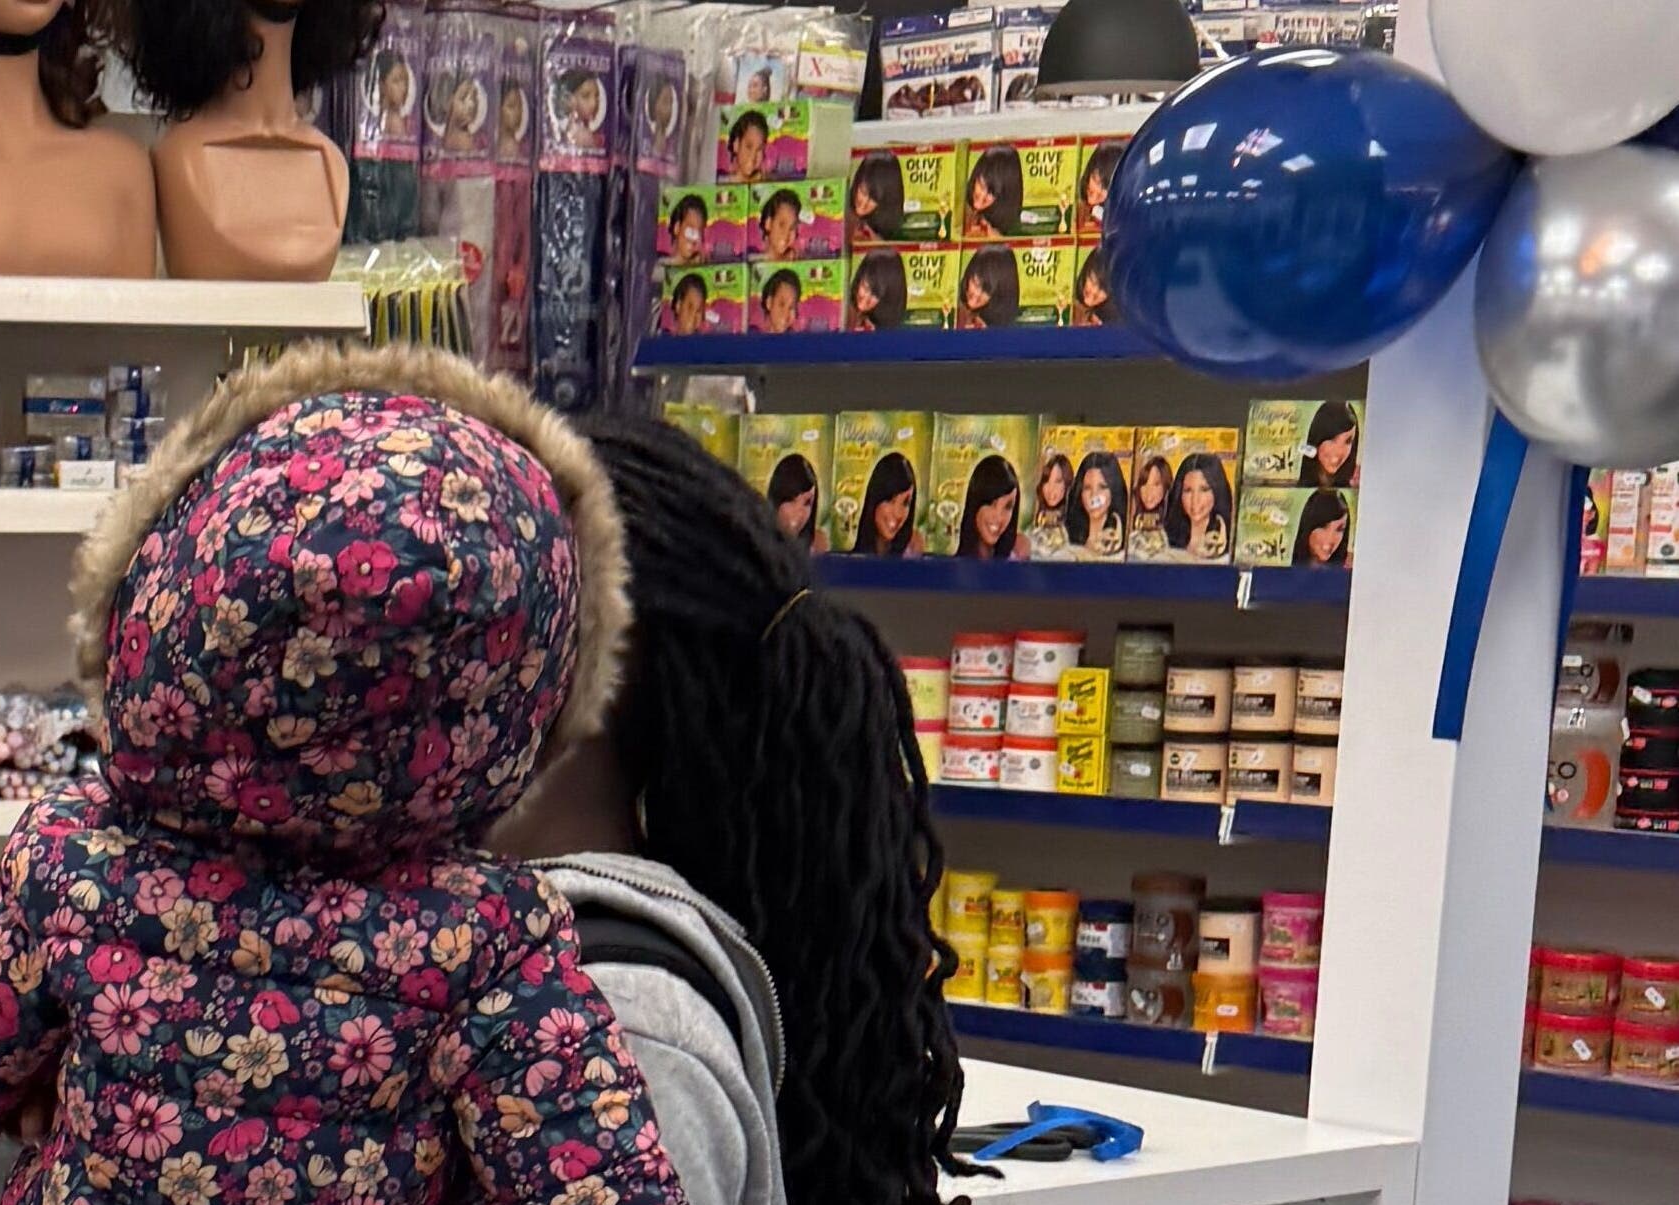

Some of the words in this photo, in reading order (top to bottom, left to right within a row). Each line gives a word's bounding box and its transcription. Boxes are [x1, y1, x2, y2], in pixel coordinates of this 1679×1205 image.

[906, 157, 943, 171] OLIVE
[1026, 150, 1064, 165] OLIVE
[909, 171, 940, 190] OIL
[1029, 164, 1060, 184] OIL
[909, 255, 946, 269] OLIVE
[913, 269, 943, 288] OIL
[1025, 264, 1057, 284] OIL
